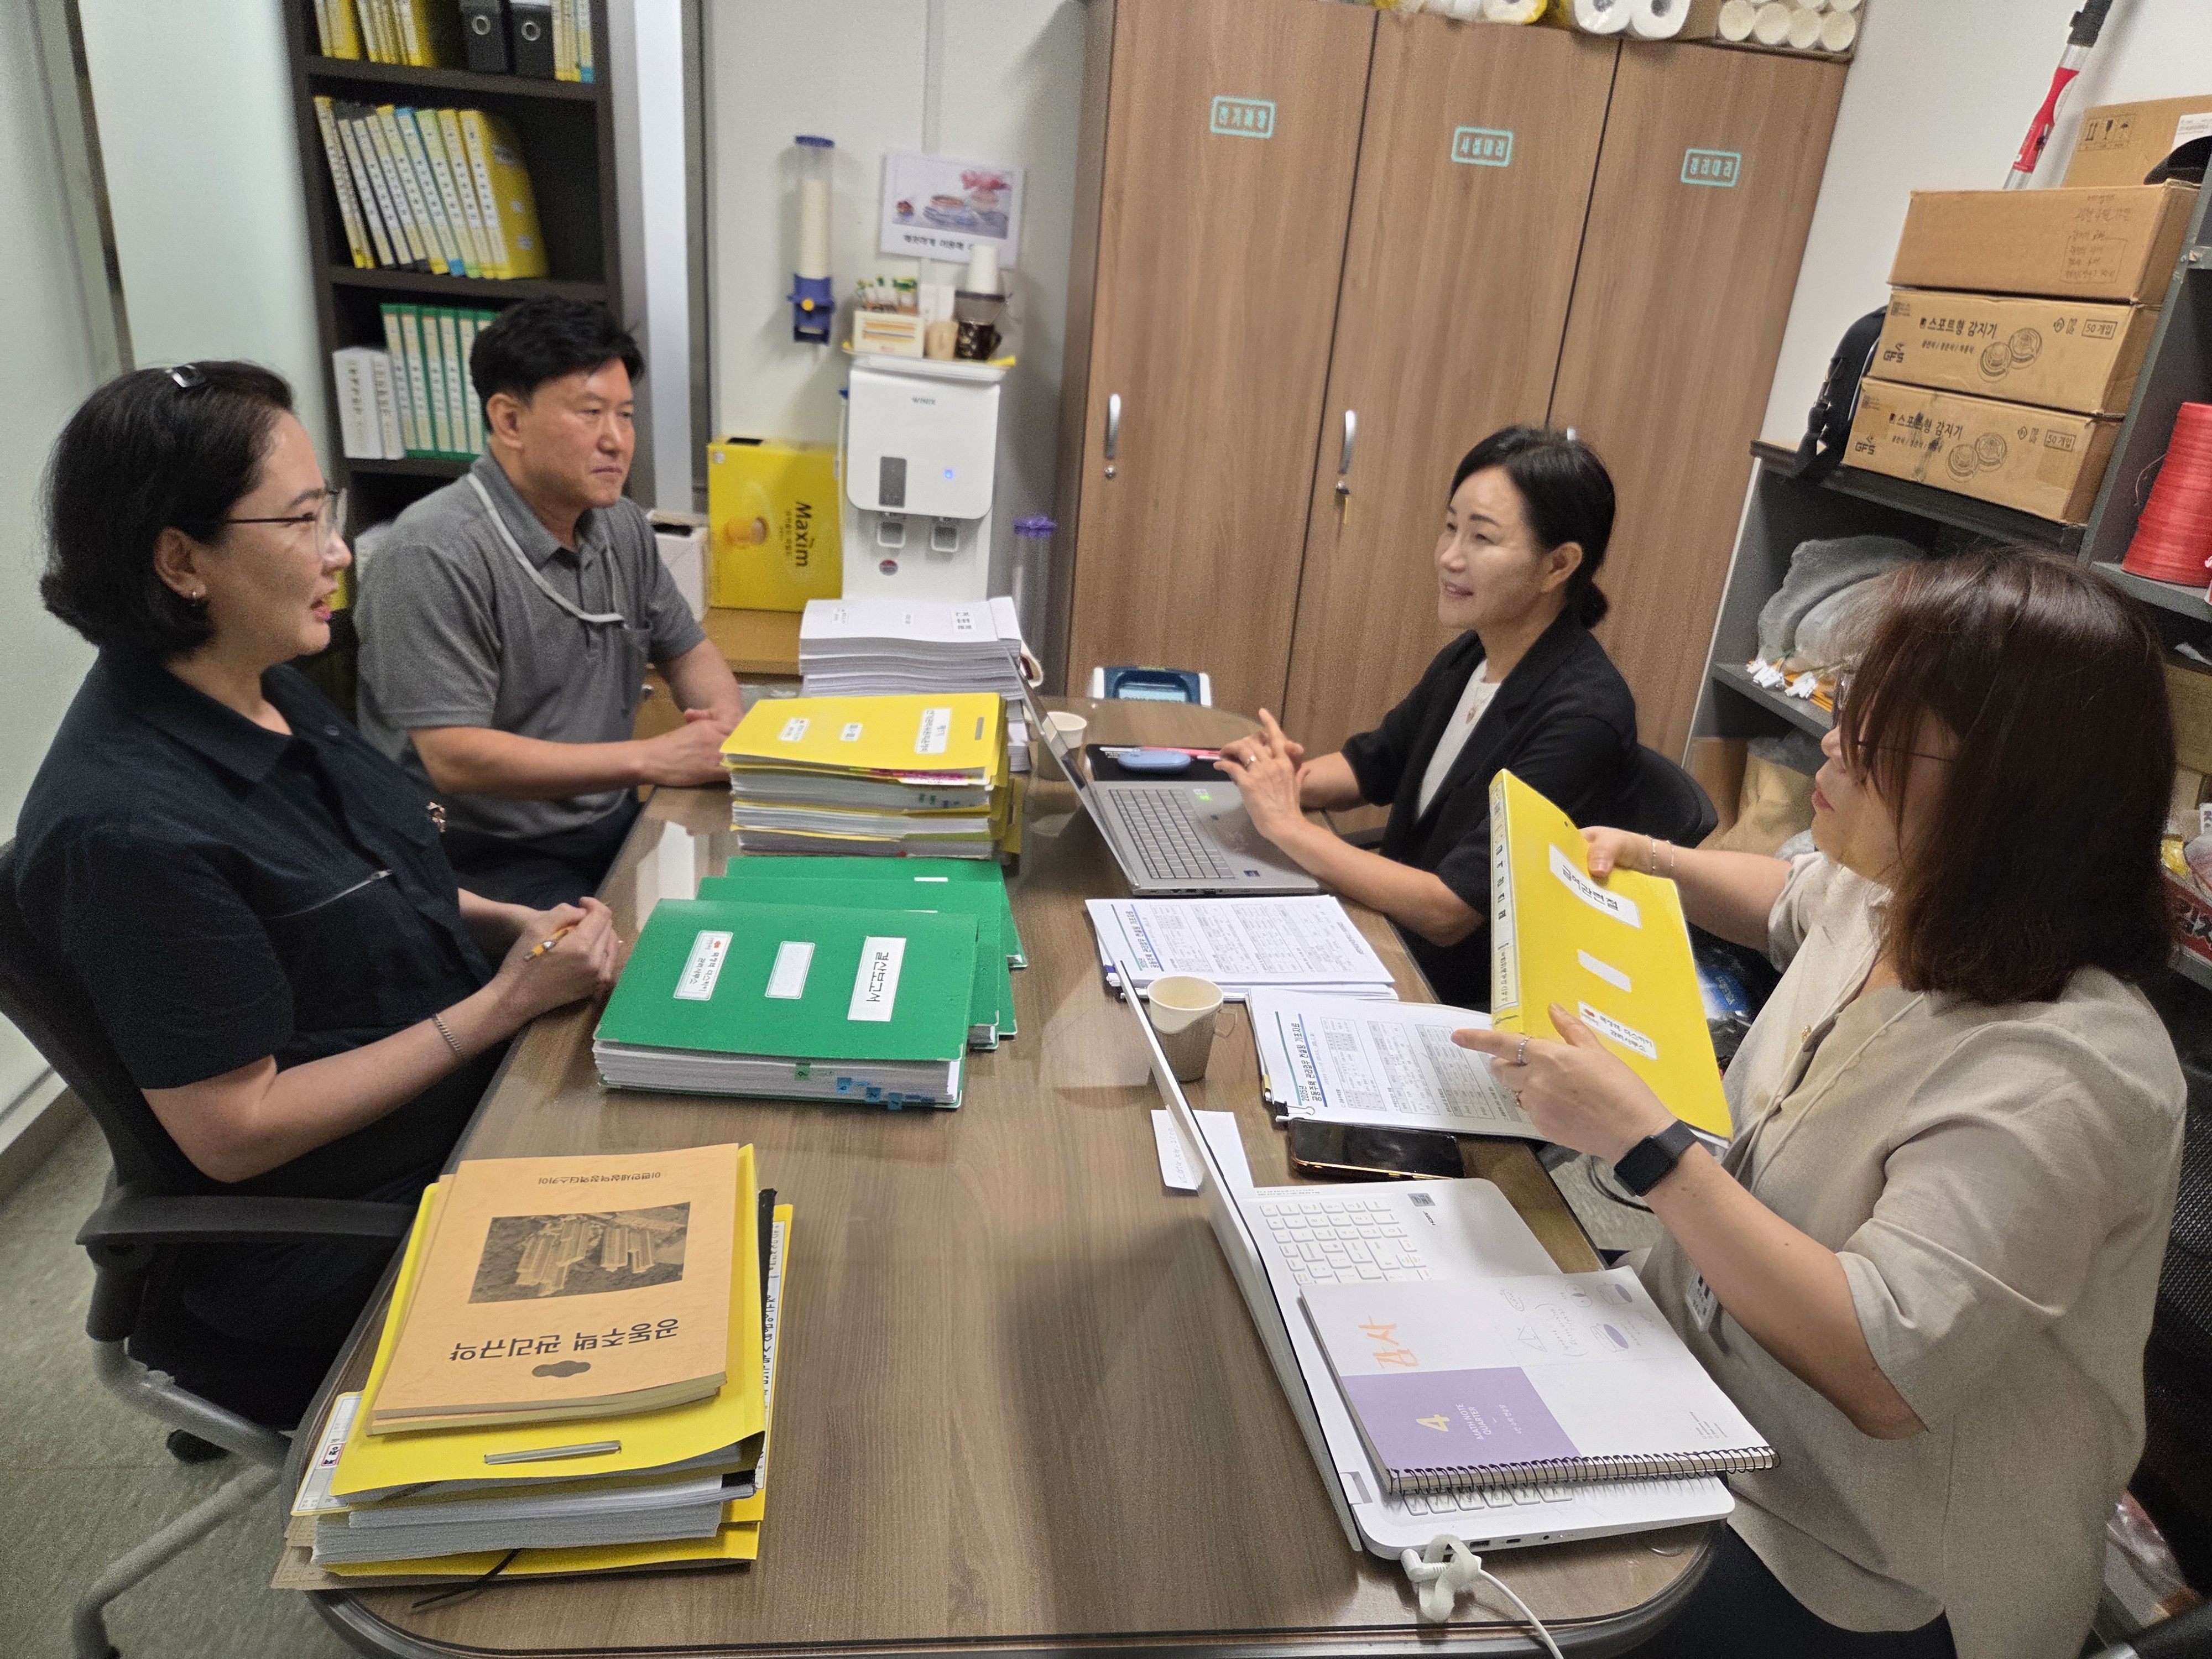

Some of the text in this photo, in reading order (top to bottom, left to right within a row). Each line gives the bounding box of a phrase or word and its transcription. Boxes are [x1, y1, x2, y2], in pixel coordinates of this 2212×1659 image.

[1927, 318, 1997, 338] 스포트형 감지기
[2086, 324, 2096, 333] 50
[1883, 350, 1905, 363] GFS
[1897, 415, 1964, 440] 스포형 감지기
[1855, 442, 1876, 455] GFS
[2047, 434, 2057, 444] 50
[795, 501, 814, 567] Maxim
[866, 952, 889, 1002] 결산보고서
[1291, 1023, 1303, 1042] 기초자료
[1296, 1045, 1308, 1058] 컨설팅
[1301, 1060, 1315, 1079] 관리업무
[1298, 1086, 1310, 1102] 2025년
[1307, 1081, 1322, 1102] 공동주택
[538, 1172, 661, 1185] 이편한세상덕정역더스카이
[449, 1319, 679, 1361] 공동주택 관리규약
[1358, 1314, 1419, 1369] 감사
[1415, 1414, 1451, 1432] 4
[1455, 1403, 1484, 1440] MATH NOTE
[1468, 1406, 1491, 1435] QUARTER
